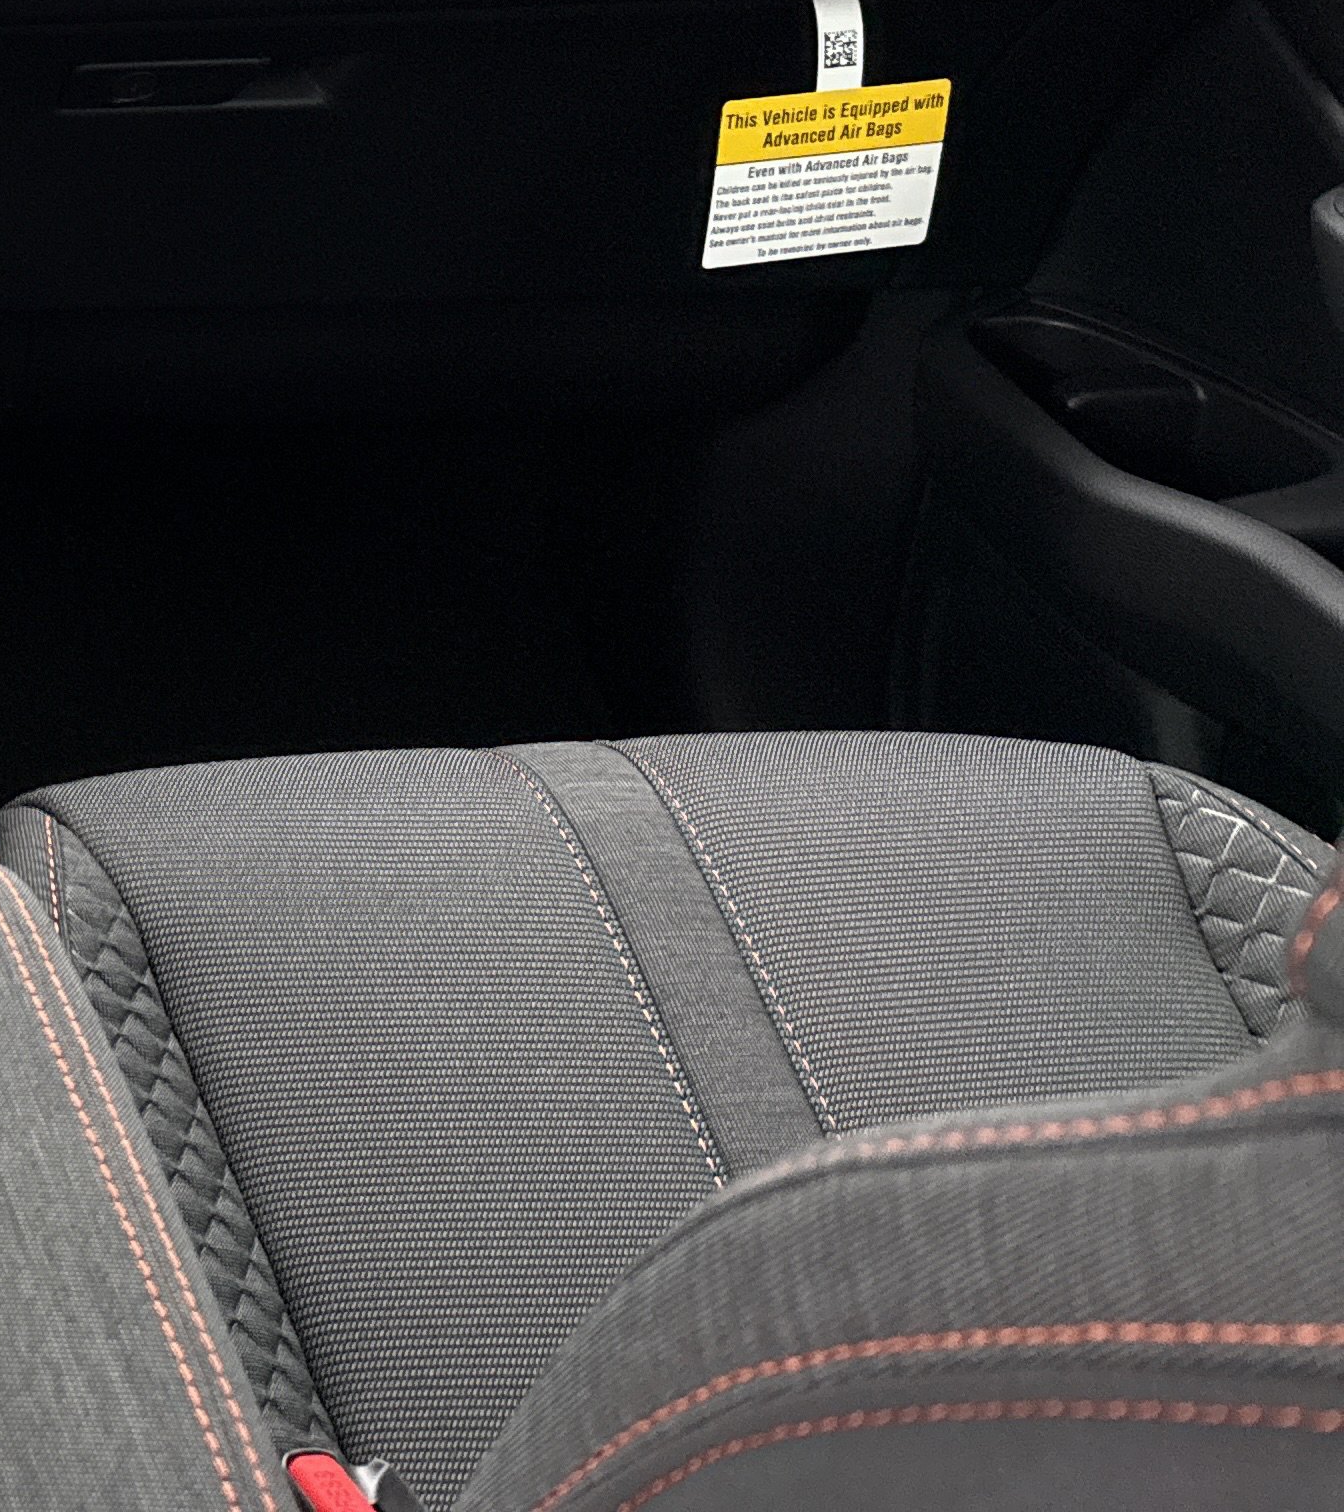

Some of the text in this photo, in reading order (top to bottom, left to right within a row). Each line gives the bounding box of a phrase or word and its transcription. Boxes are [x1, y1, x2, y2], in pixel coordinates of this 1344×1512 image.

[726, 93, 945, 129] This Vehicle is Equipped with
[762, 121, 902, 148] Advanced Air Bags
[748, 152, 909, 178] Even with Advanced Air Bags
[717, 185, 750, 195] Children
[880, 170, 889, 179] by
[716, 199, 730, 208] The
[732, 197, 750, 206] back
[752, 195, 770, 204] seat
[713, 212, 736, 221] Never
[711, 225, 739, 235] Always
[709, 239, 724, 248] See
[757, 249, 766, 257] To
